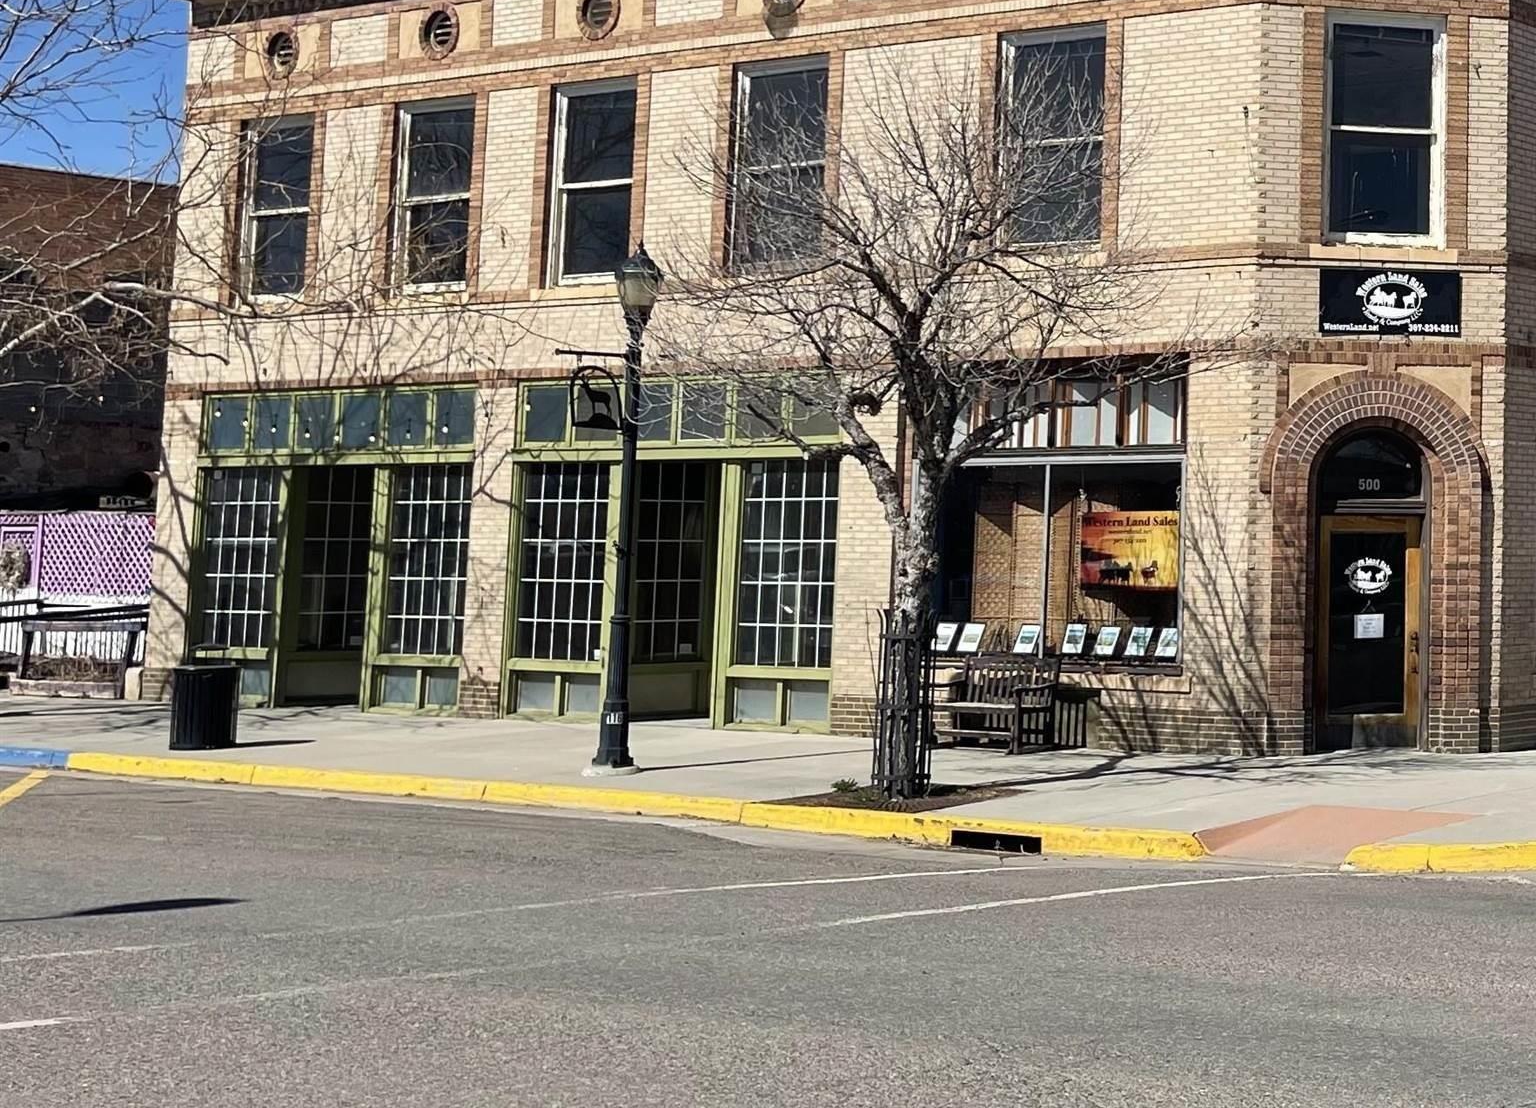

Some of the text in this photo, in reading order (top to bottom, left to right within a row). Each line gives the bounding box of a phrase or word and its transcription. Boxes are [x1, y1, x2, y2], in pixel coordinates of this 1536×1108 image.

[1355, 272, 1428, 298] Western Land Sales
[1359, 478, 1380, 490] 500
[1126, 516, 1151, 527] Land
[1153, 516, 1178, 527] Sales
